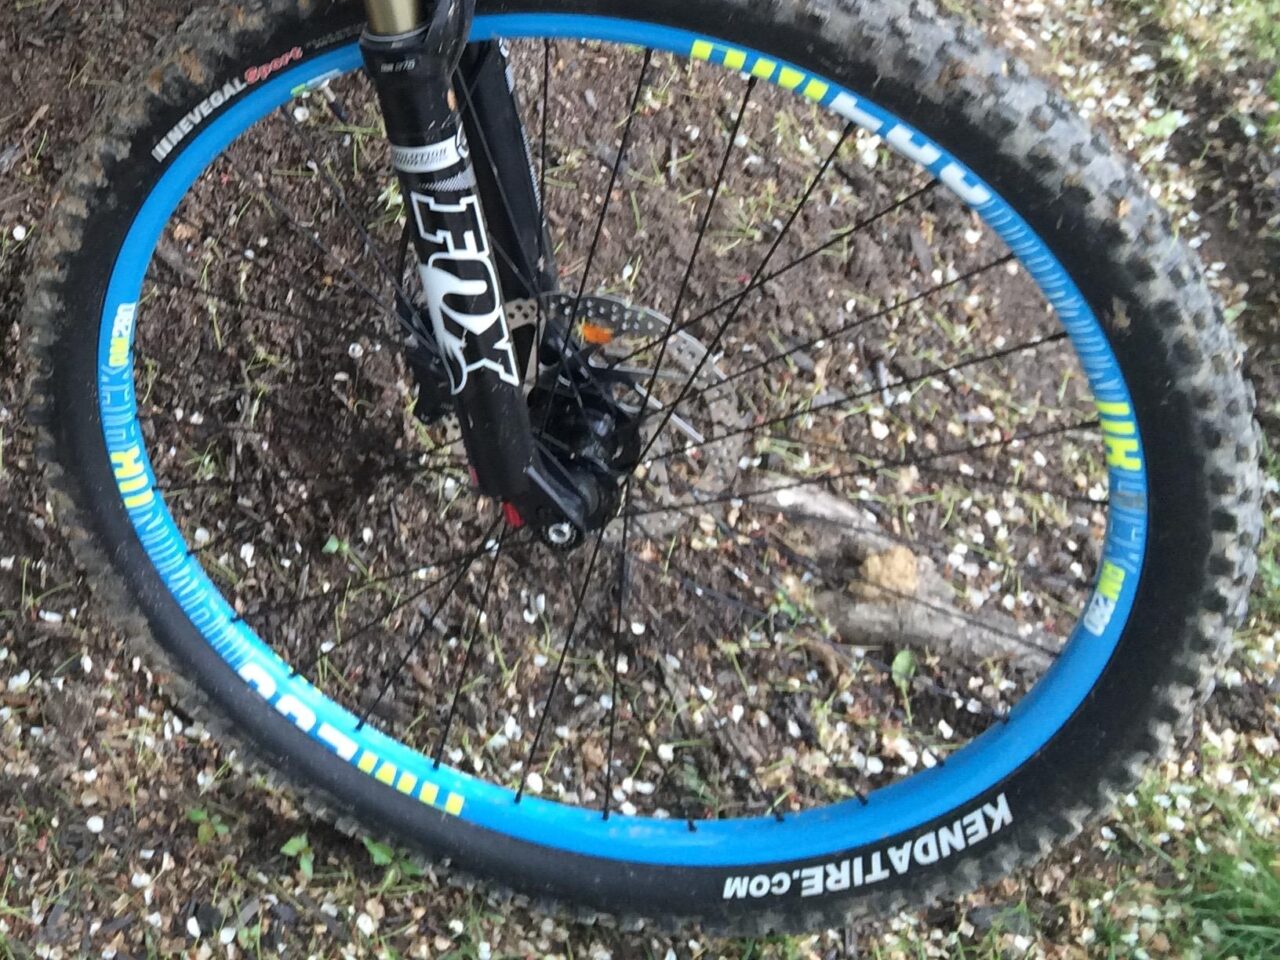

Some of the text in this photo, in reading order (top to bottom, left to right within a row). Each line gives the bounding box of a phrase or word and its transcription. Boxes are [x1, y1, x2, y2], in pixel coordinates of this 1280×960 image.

[165, 75, 248, 147] NEVEGAL
[410, 190, 520, 395] FOX
[722, 791, 1015, 901] KENDATIRE.COM
